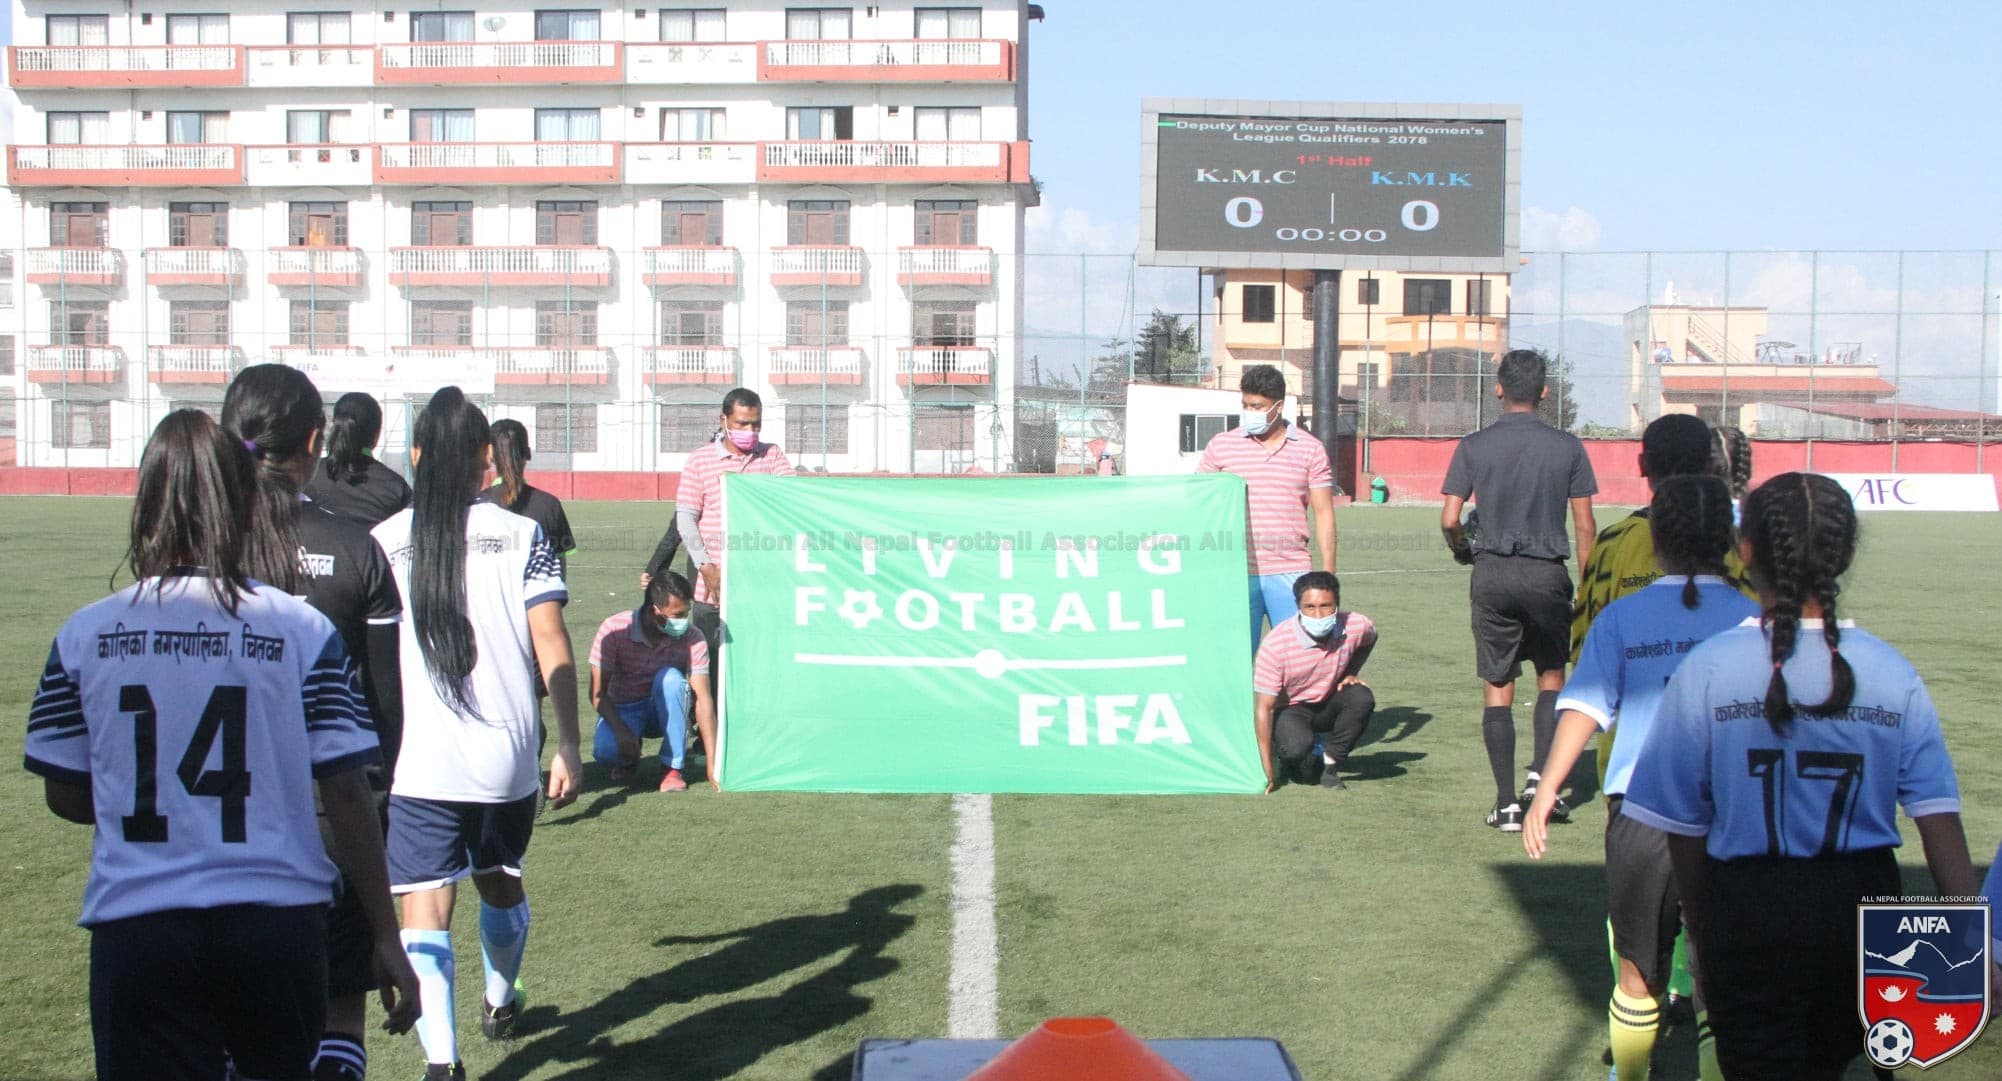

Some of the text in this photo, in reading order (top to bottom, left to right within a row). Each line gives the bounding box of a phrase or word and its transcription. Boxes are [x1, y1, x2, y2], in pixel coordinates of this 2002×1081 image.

[1176, 120, 1485, 135] Deputy Mayor Cup National Women's
[1232, 132, 1428, 144] League Qualifiers 2078
[1328, 155, 1373, 166] Half
[1194, 168, 1297, 184] K.M.C
[1371, 171, 1473, 187] K.M.K
[1224, 196, 1264, 228] 0
[1400, 199, 1440, 232] 0
[1275, 227, 1387, 243] 00:00
[1852, 478, 1919, 505] AFC
[795, 532, 1183, 579] LIVING
[1018, 692, 1193, 746] FIFA
[119, 685, 252, 843] 14
[1746, 748, 1866, 857] 17
